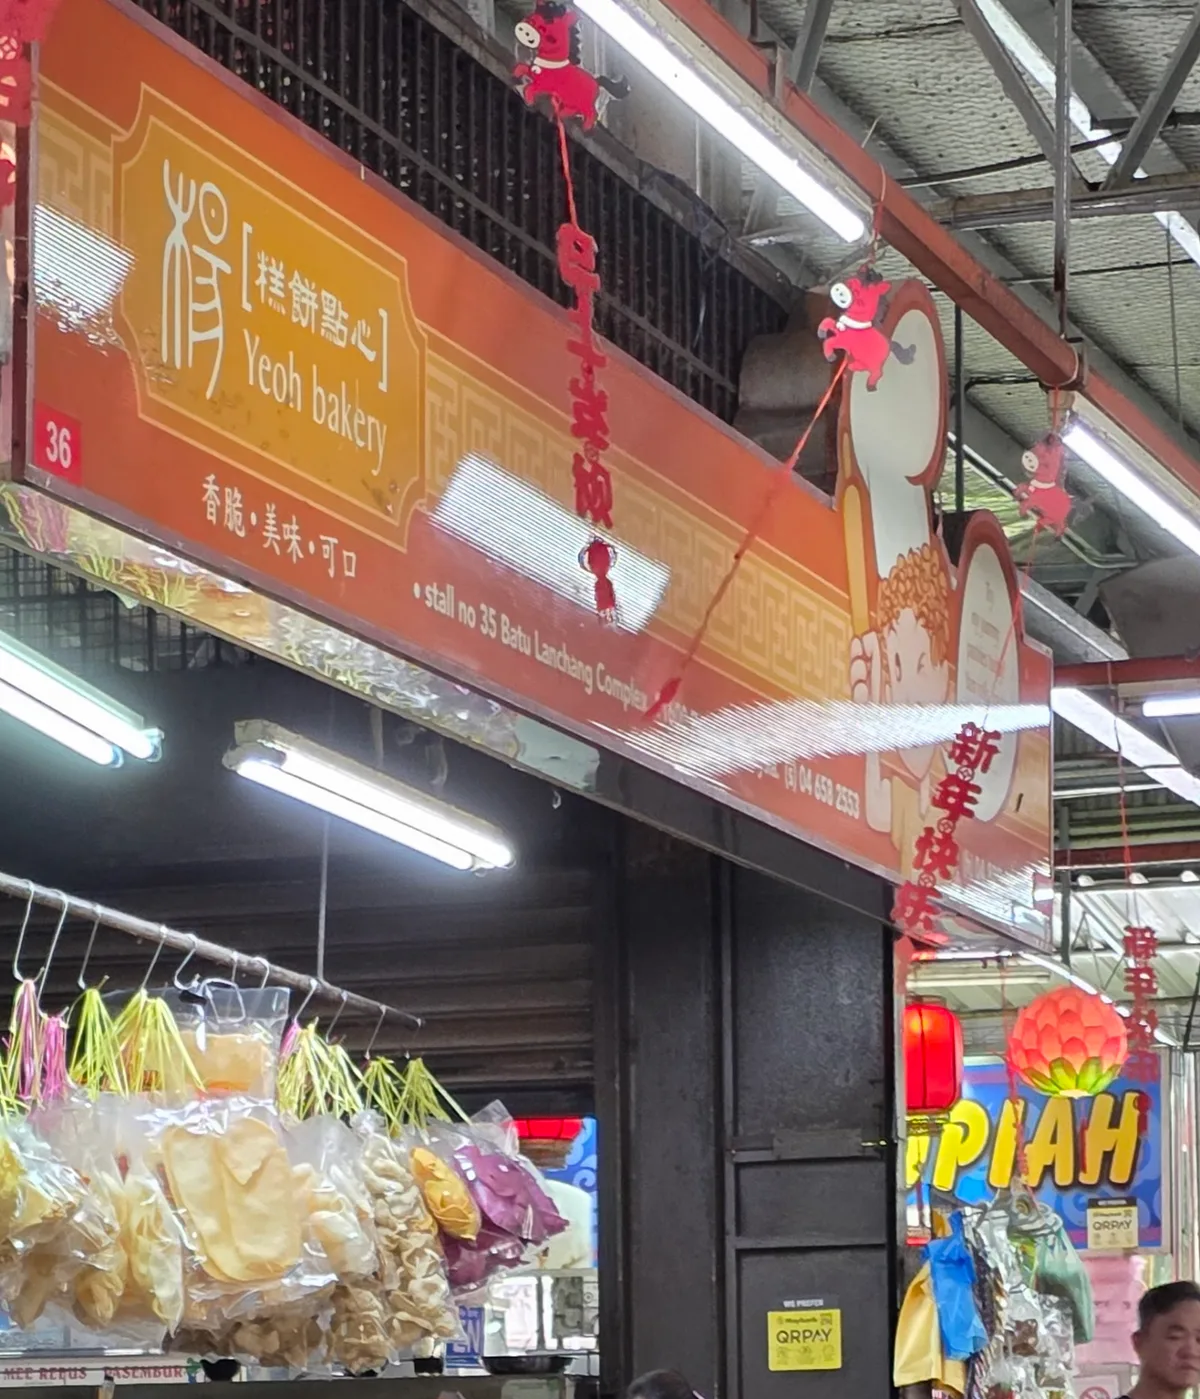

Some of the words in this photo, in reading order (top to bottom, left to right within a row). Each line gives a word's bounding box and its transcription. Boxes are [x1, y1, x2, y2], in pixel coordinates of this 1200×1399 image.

[243, 328, 302, 412] Yeoh
[312, 364, 387, 476] bakery
[46, 420, 72, 469] 36
[424, 583, 455, 619] stall
[458, 601, 476, 628] no
[480, 604, 497, 639] 35
[501, 613, 531, 655] Batu
[534, 630, 593, 695] Lanchang
[596, 661, 648, 711] Complex
[800, 764, 813, 795] 04
[1092, 1219, 1133, 1231] QRPAY
[776, 1327, 832, 1344] QRPAY
